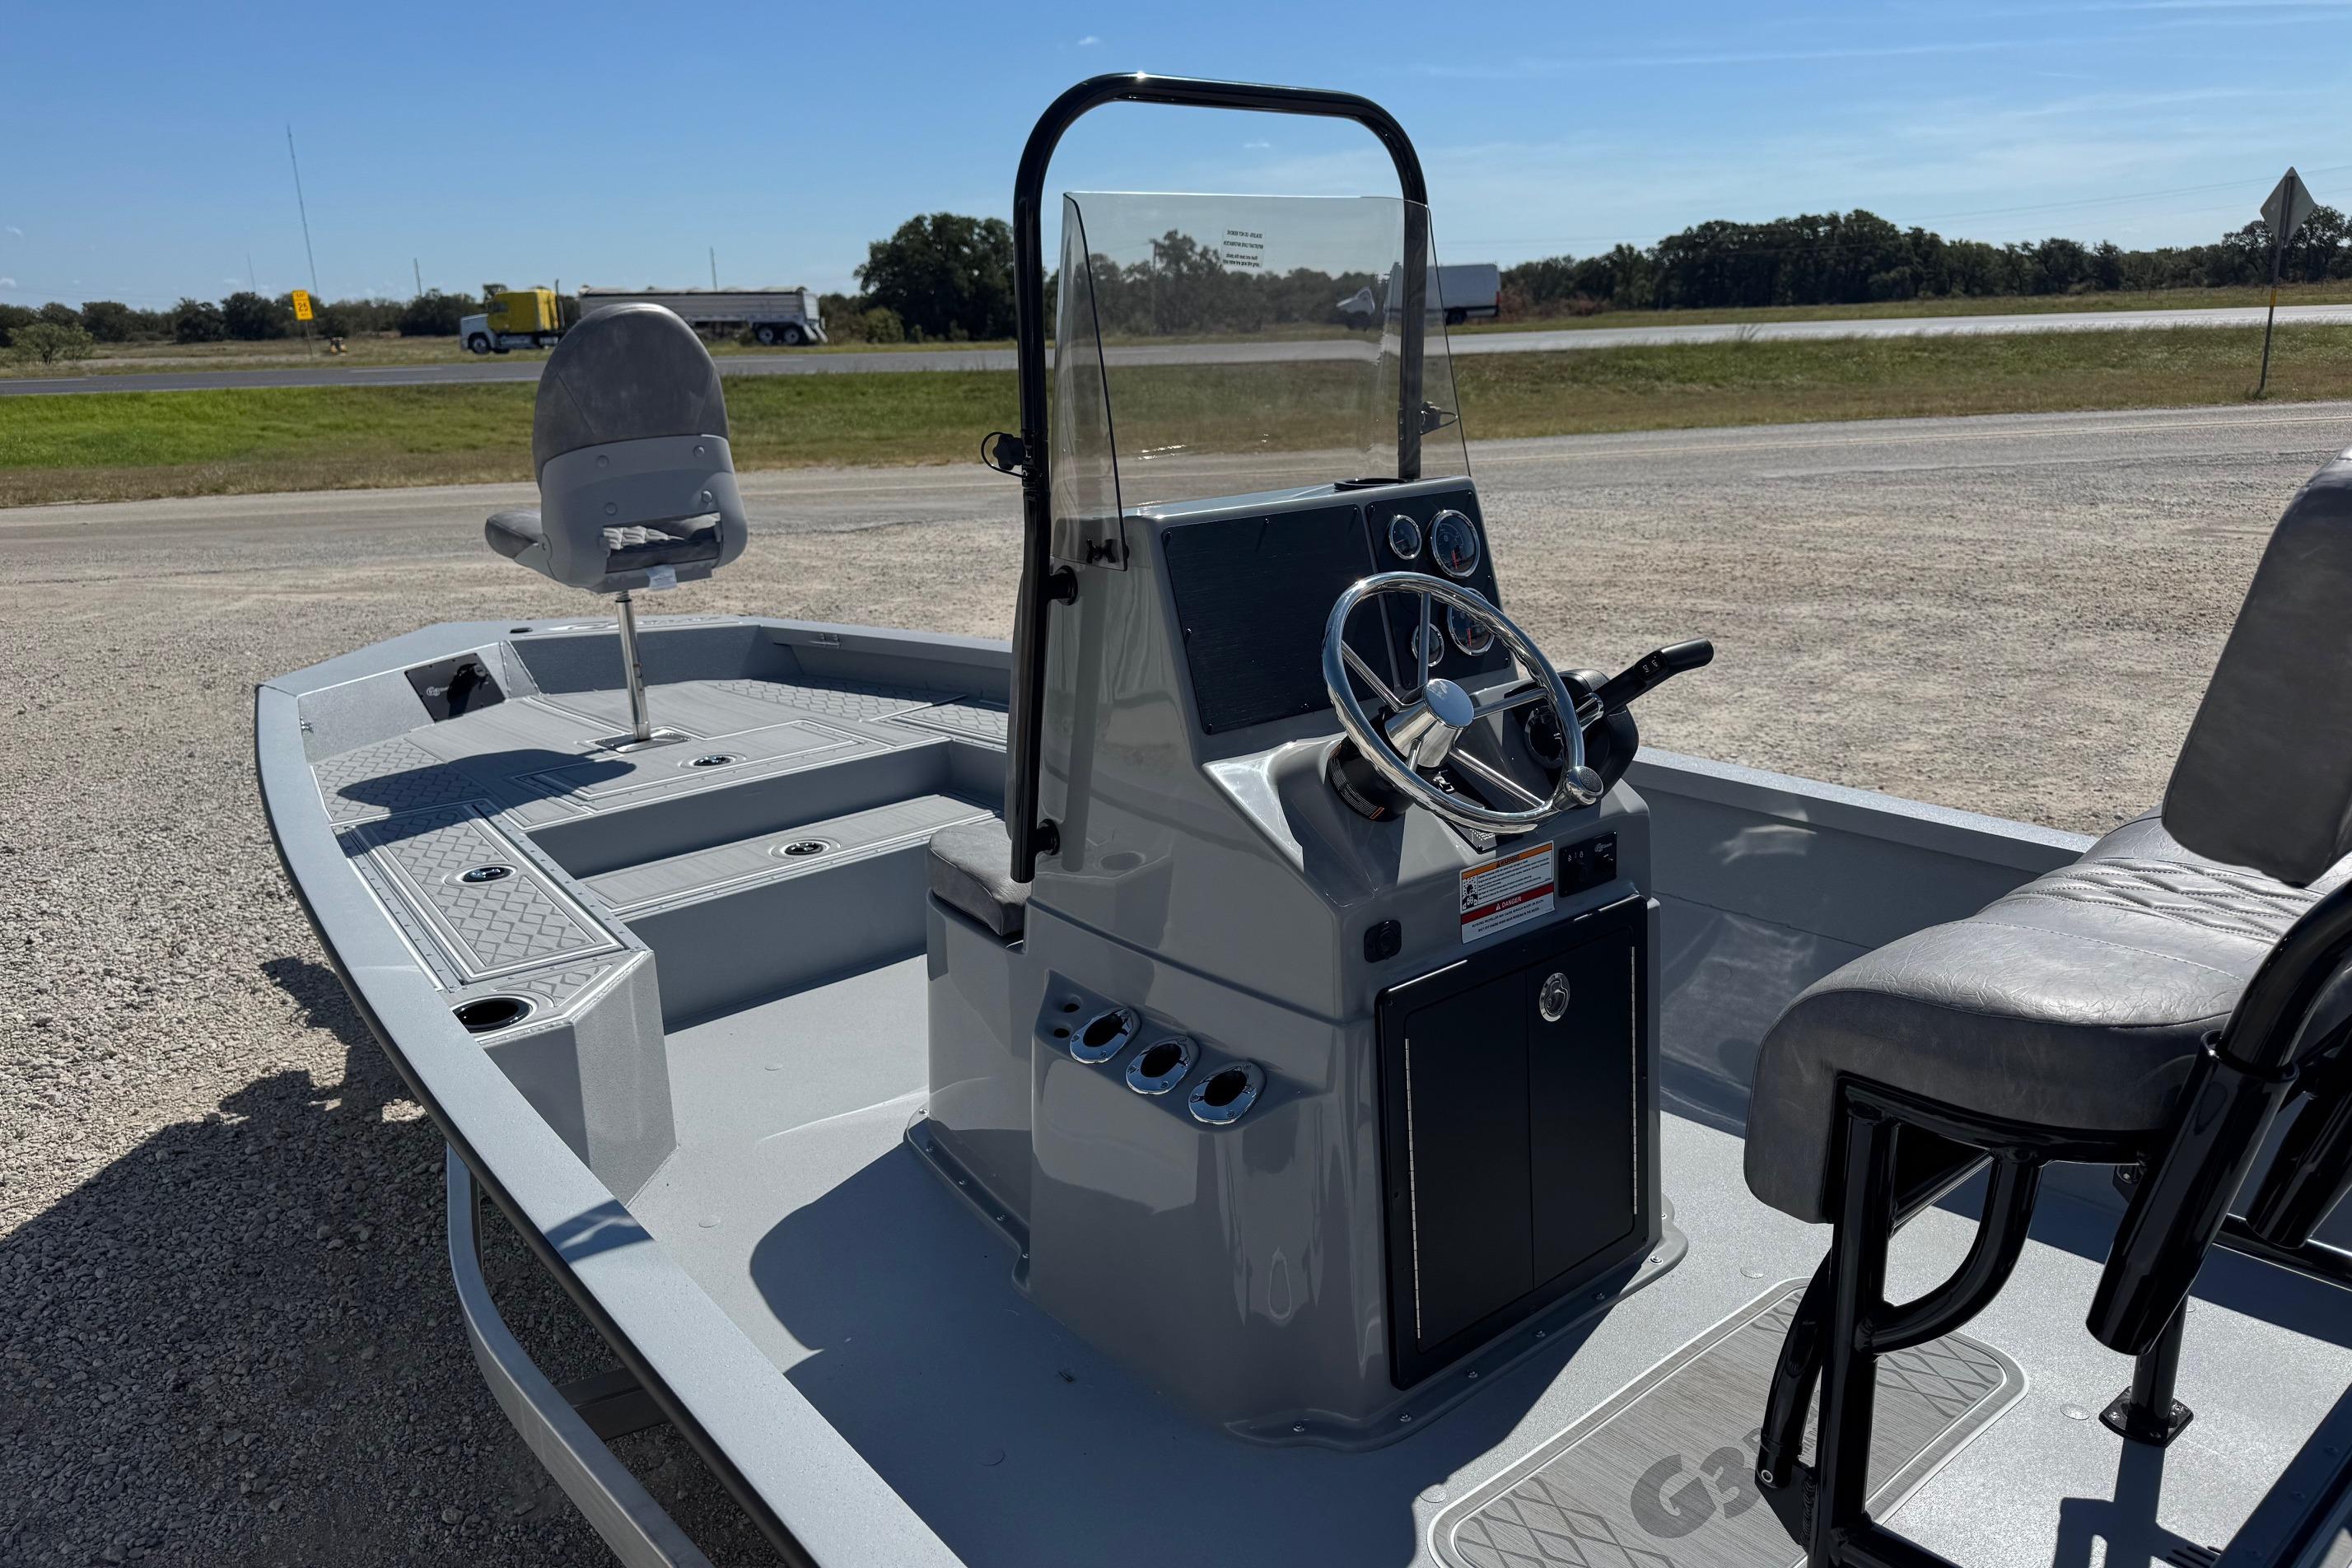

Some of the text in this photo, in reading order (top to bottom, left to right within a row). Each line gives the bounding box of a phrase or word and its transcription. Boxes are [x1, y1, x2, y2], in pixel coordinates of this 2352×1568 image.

[297, 301, 309, 312] 25
[1501, 896, 1522, 908] DANGER
[1630, 1445, 1762, 1539] G3
